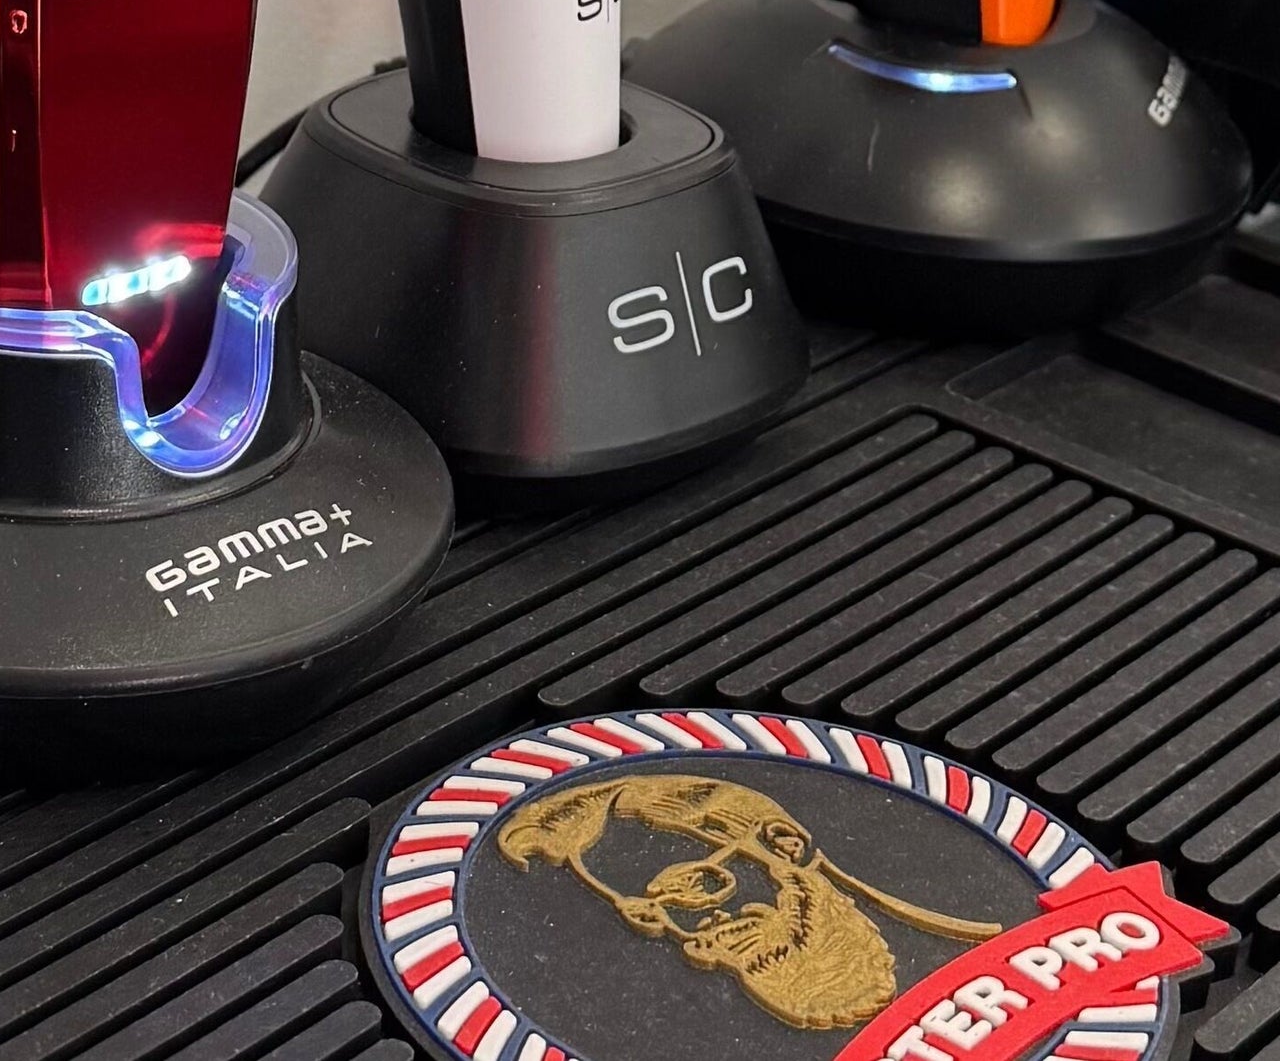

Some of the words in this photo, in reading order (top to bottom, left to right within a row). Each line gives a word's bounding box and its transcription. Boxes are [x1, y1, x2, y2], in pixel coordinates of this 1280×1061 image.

[145, 503, 352, 592] Gamma+
[163, 532, 373, 618] ITALIA
[876, 975, 1029, 1061] TER
[1009, 912, 1161, 991] PRO
